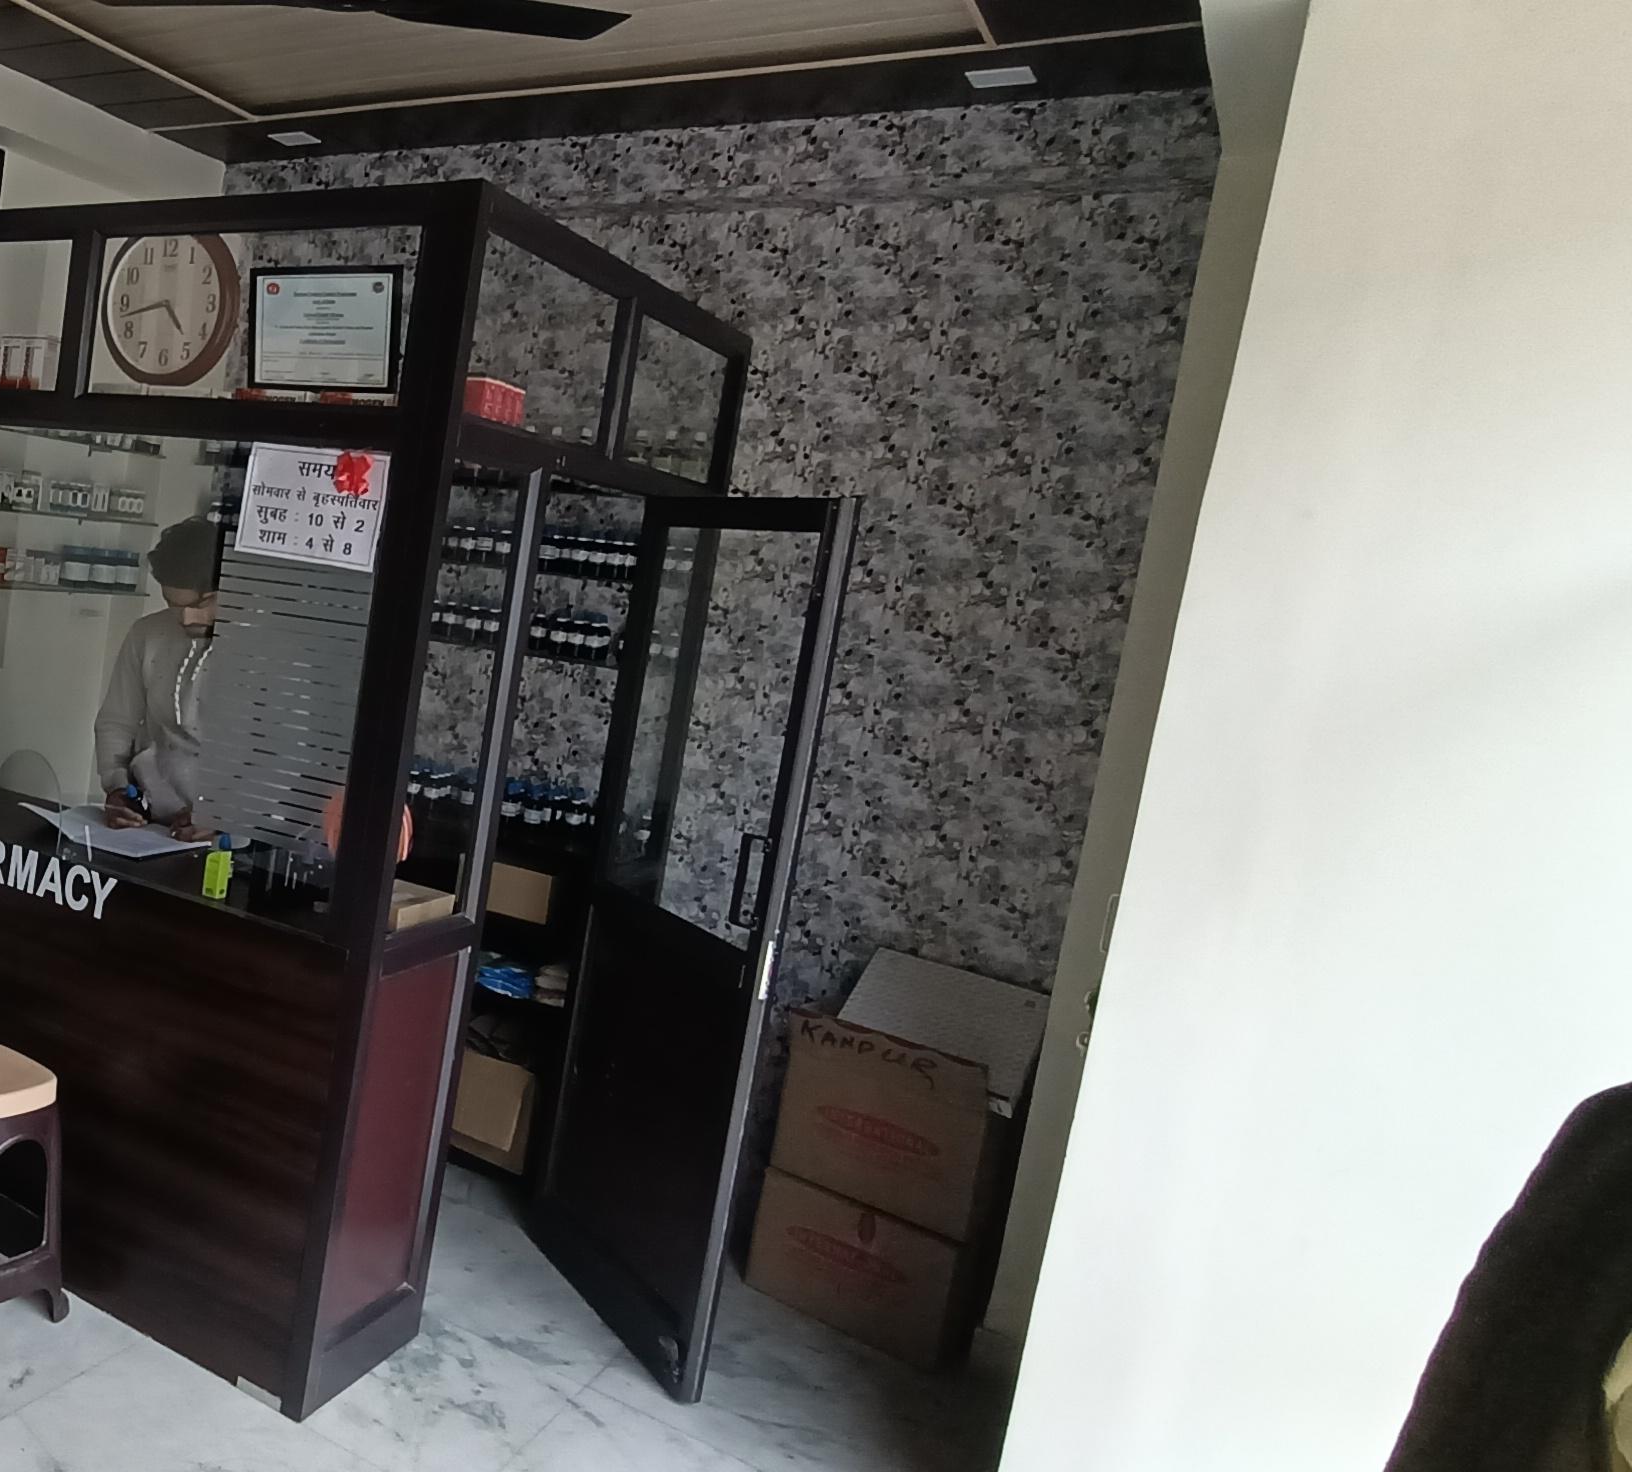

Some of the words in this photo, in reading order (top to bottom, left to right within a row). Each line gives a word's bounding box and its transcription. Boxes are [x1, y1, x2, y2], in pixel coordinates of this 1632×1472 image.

[144, 247, 155, 265] 11
[162, 238, 179, 258] 12
[189, 246, 196, 265] 1
[126, 267, 140, 285] 10
[202, 266, 213, 285] 2
[120, 294, 131, 313] 9
[206, 294, 217, 313] 3
[123, 321, 134, 339] 8
[198, 322, 208, 340] 4
[138, 341, 148, 359] 7
[158, 349, 169, 367] 6
[180, 342, 192, 360] 5
[298, 460, 338, 480] समय
[252, 481, 292, 500] सोमवार
[296, 486, 307, 501] से
[256, 504, 289, 524] सुबह
[308, 512, 324, 528] 10
[331, 511, 347, 531] से
[353, 519, 366, 534] 2
[258, 528, 288, 546] शाम
[304, 536, 314, 550] 4
[321, 533, 335, 553] से
[342, 542, 353, 556] 8
